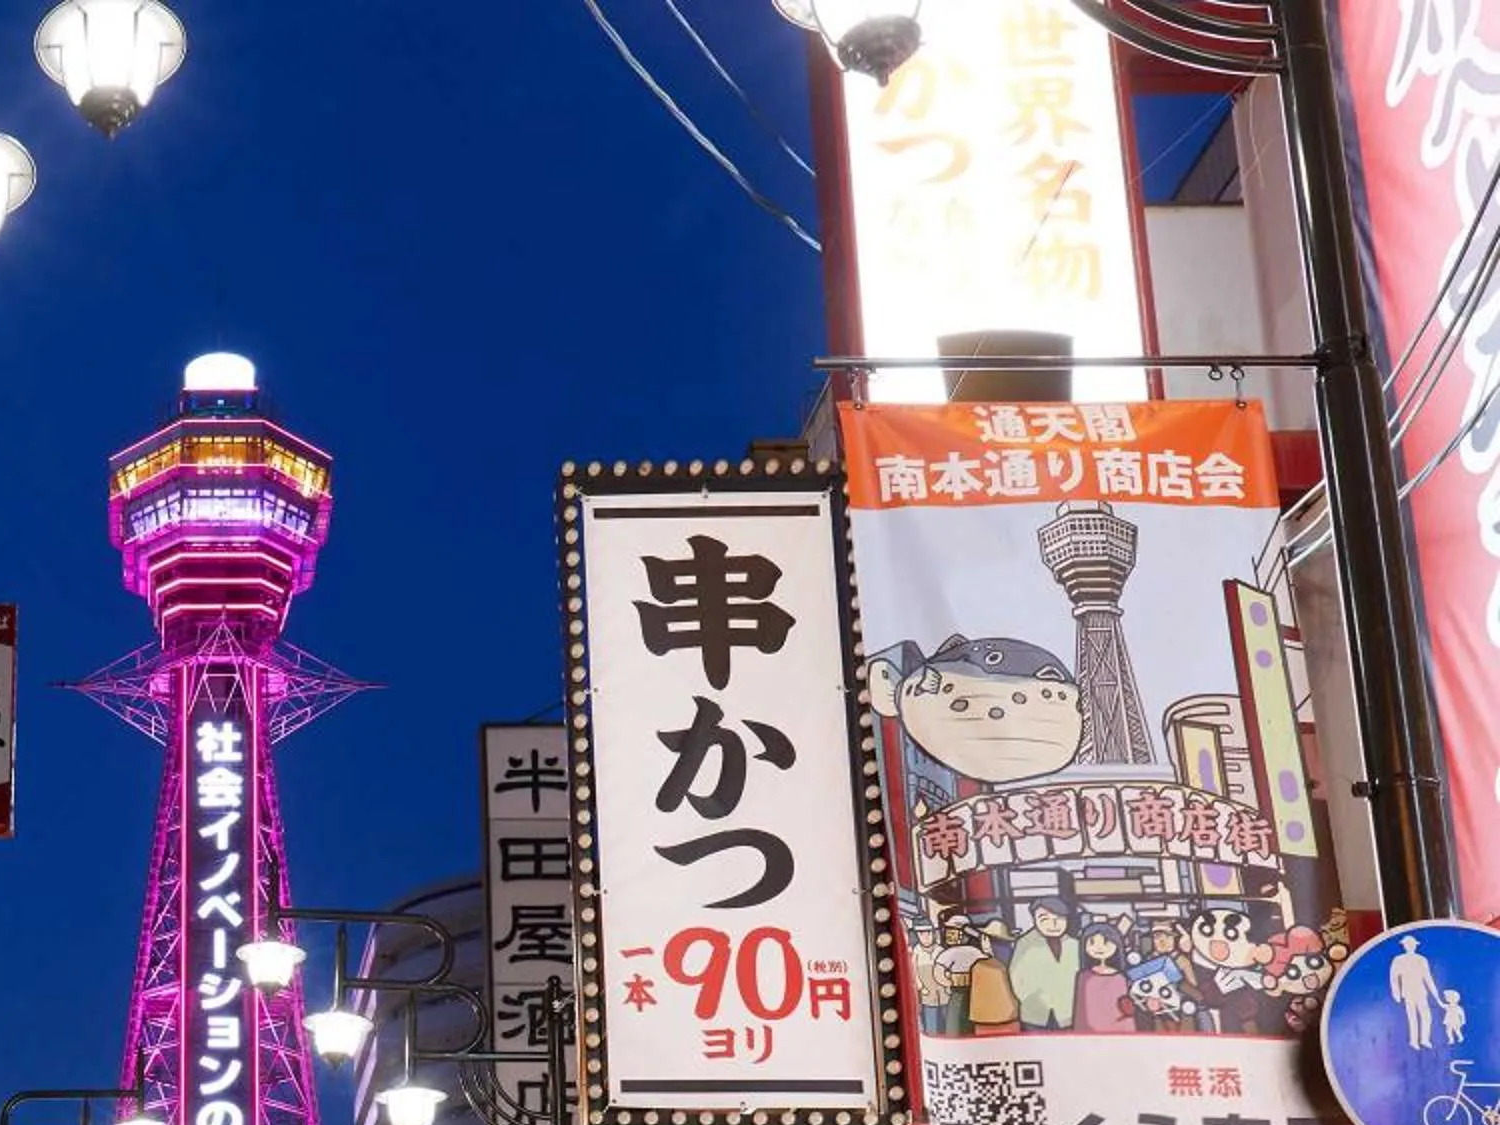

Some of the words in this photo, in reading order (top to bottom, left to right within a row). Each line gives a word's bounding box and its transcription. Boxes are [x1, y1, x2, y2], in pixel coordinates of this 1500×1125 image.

[975, 404, 1136, 444] 通天閣
[874, 449, 1245, 500] 南本通り商店会
[631, 534, 797, 908] 串かつ
[920, 786, 1274, 859] 南本通り商店街
[702, 1026, 774, 1065] ヨリ
[1167, 1065, 1243, 1099] 無添
